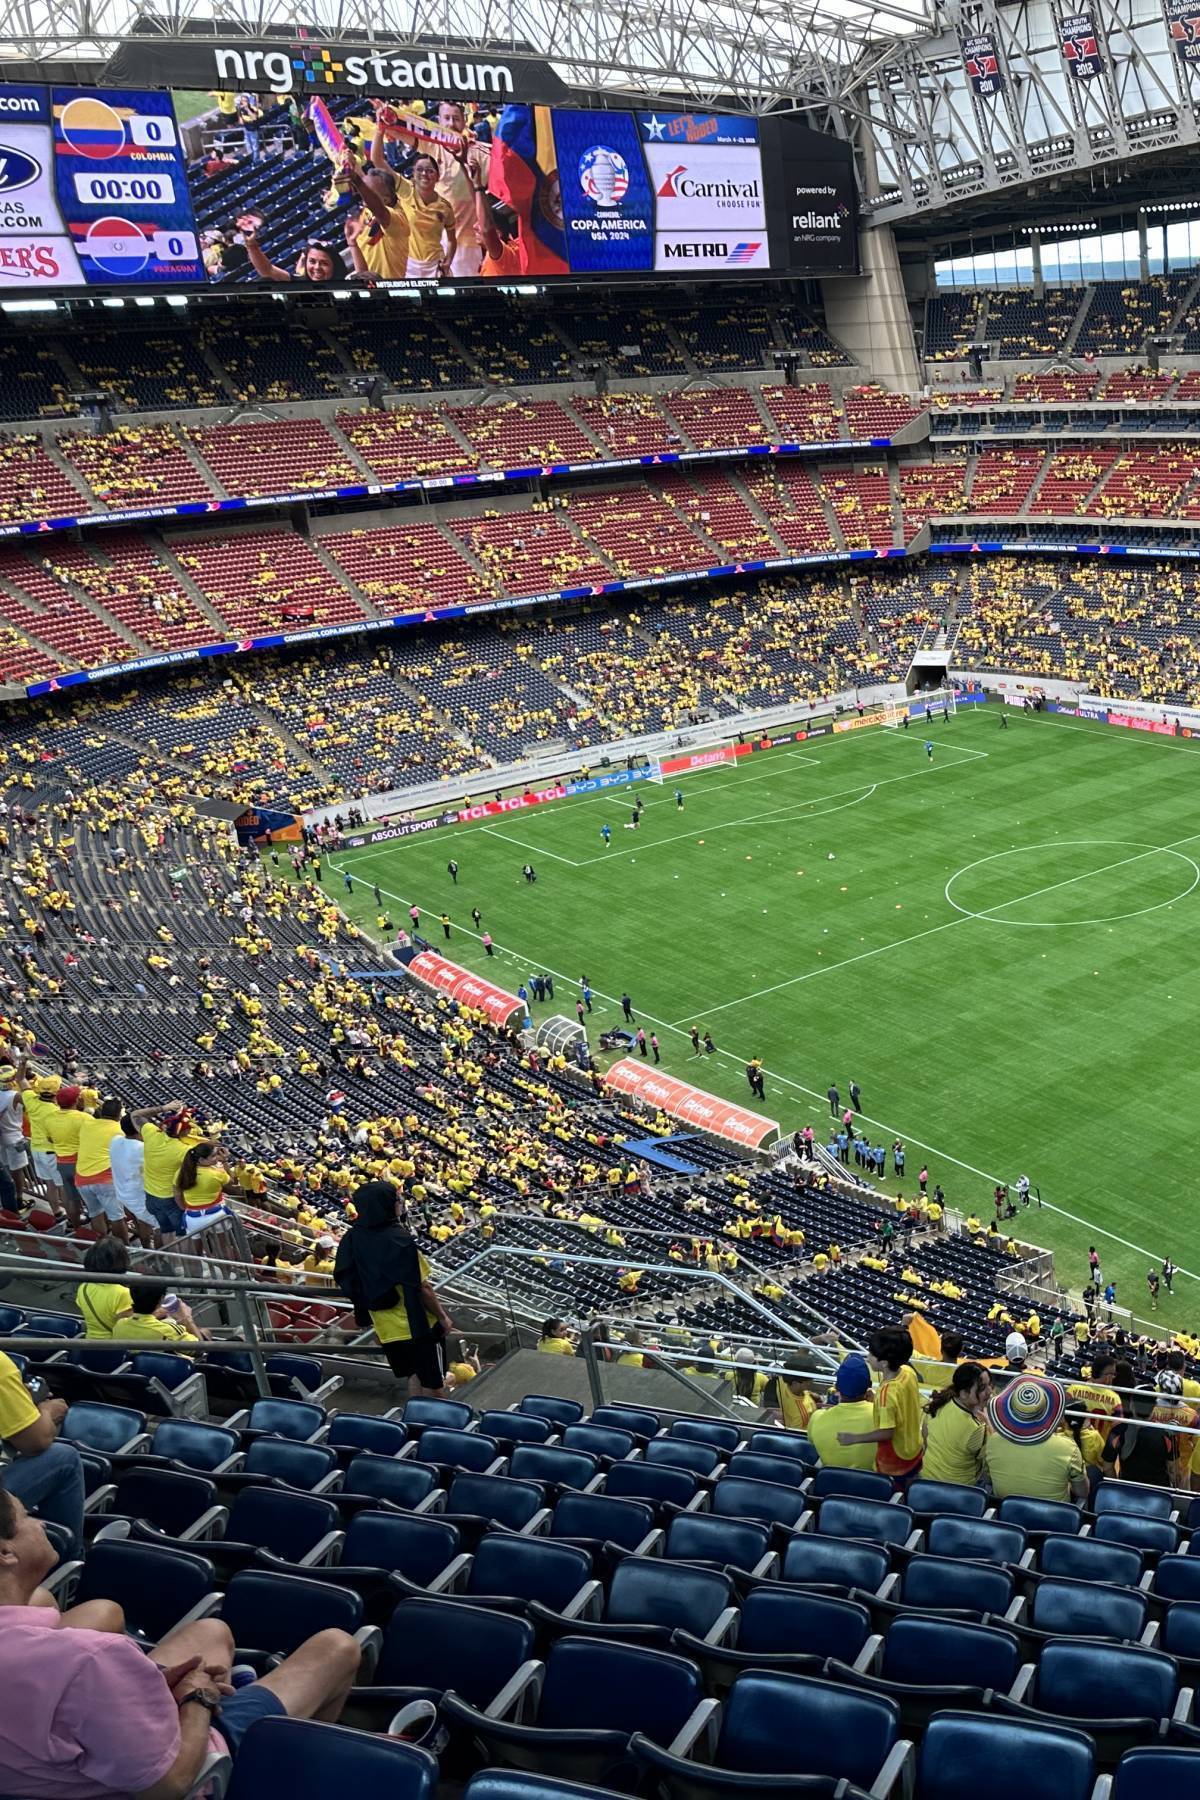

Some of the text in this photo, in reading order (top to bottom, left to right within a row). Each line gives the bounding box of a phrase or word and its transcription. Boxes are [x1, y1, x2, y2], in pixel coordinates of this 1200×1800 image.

[1061, 23, 1092, 37] CHAMPIONS
[214, 48, 514, 93] nrg stadium
[1076, 62, 1095, 77] 2012
[146, 122, 162, 141] 0
[130, 152, 176, 162] COLOMBIA
[90, 179, 162, 200] 00:00
[681, 179, 759, 198] Carnival
[796, 186, 837, 196] powered by
[717, 200, 760, 208] CHOOSE FUN
[571, 219, 646, 230] COPA AMERICA
[792, 211, 841, 228] reliant
[591, 231, 629, 240] USA 2024
[815, 235, 841, 243] company
[168, 238, 184, 256] 0
[664, 243, 727, 258] METRO
[534, 786, 566, 802] TCL
[499, 796, 530, 812] TCL
[463, 805, 492, 822] TCL
[371, 826, 410, 843] ABSOLUT
[410, 818, 438, 833] SPORT
